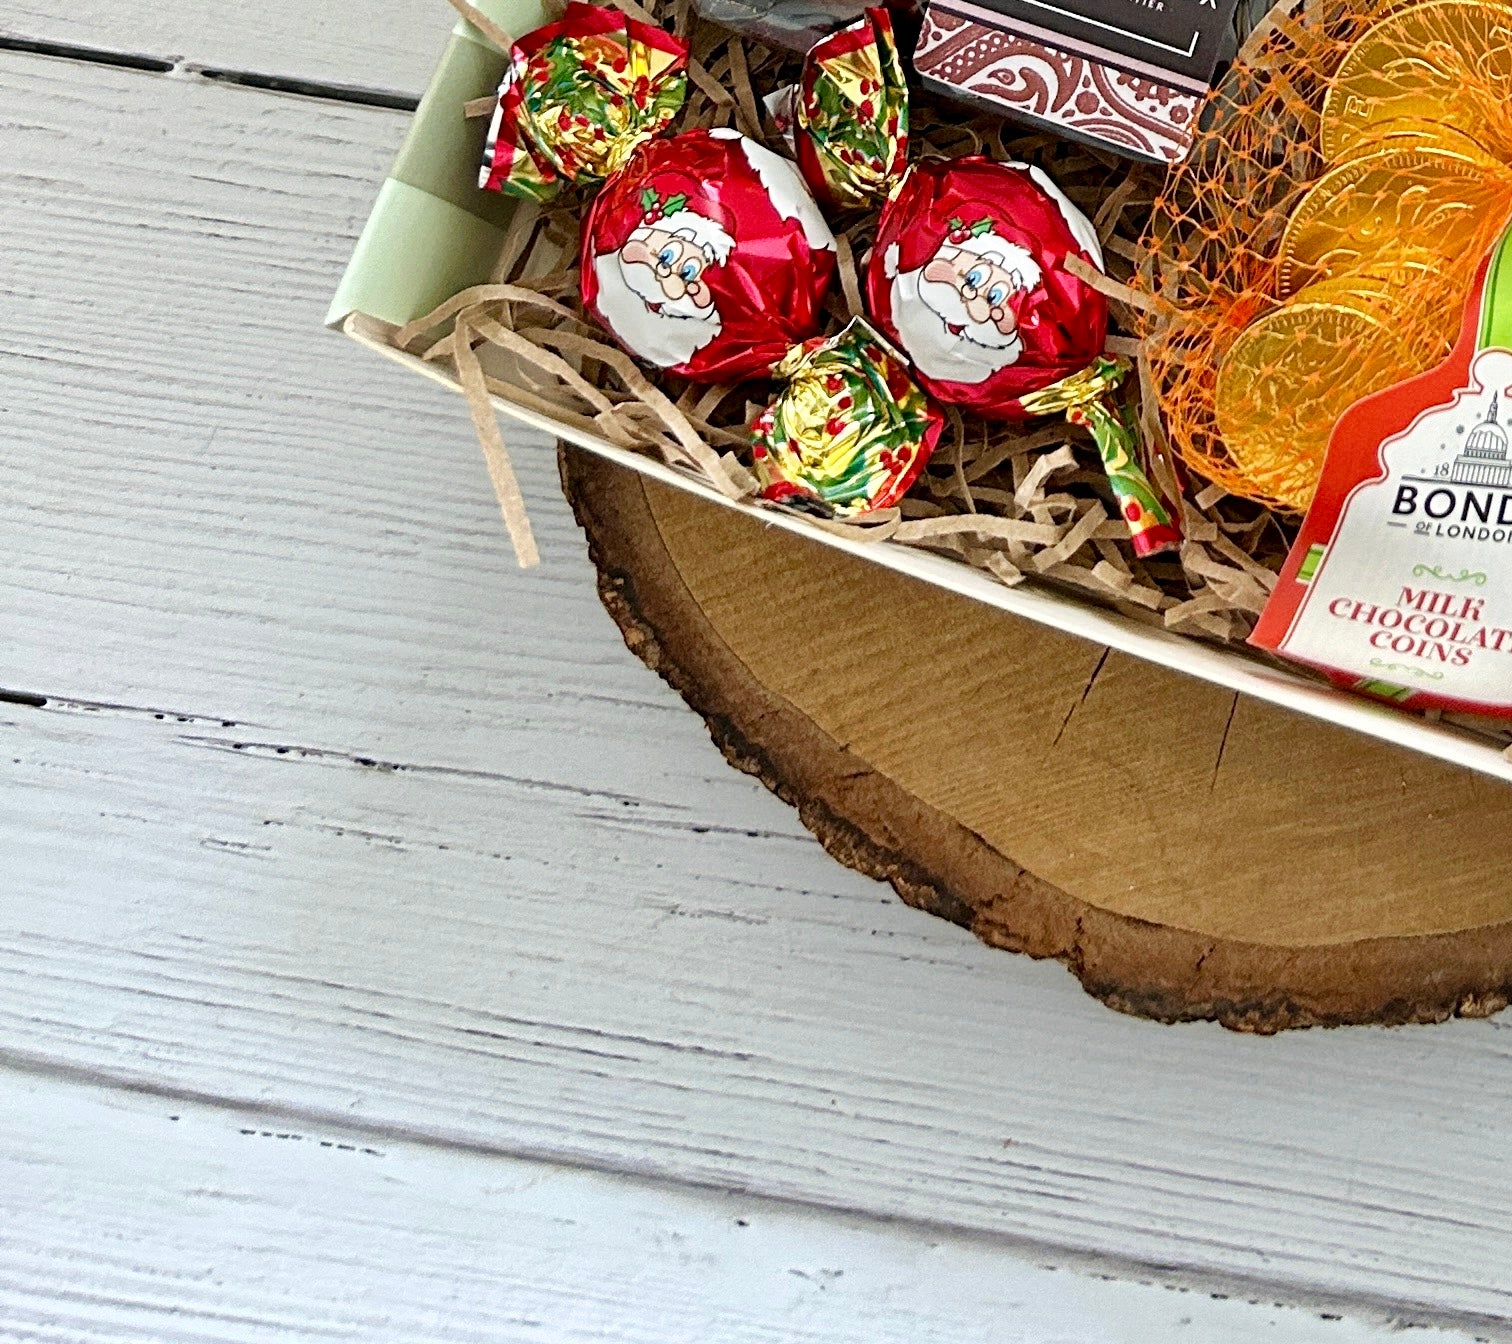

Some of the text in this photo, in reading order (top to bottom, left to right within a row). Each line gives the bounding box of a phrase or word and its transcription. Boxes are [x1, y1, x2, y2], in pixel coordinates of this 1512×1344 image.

[1415, 520, 1433, 531] OF
[1395, 586, 1486, 621] MILK
[1369, 630, 1473, 667] COINS
